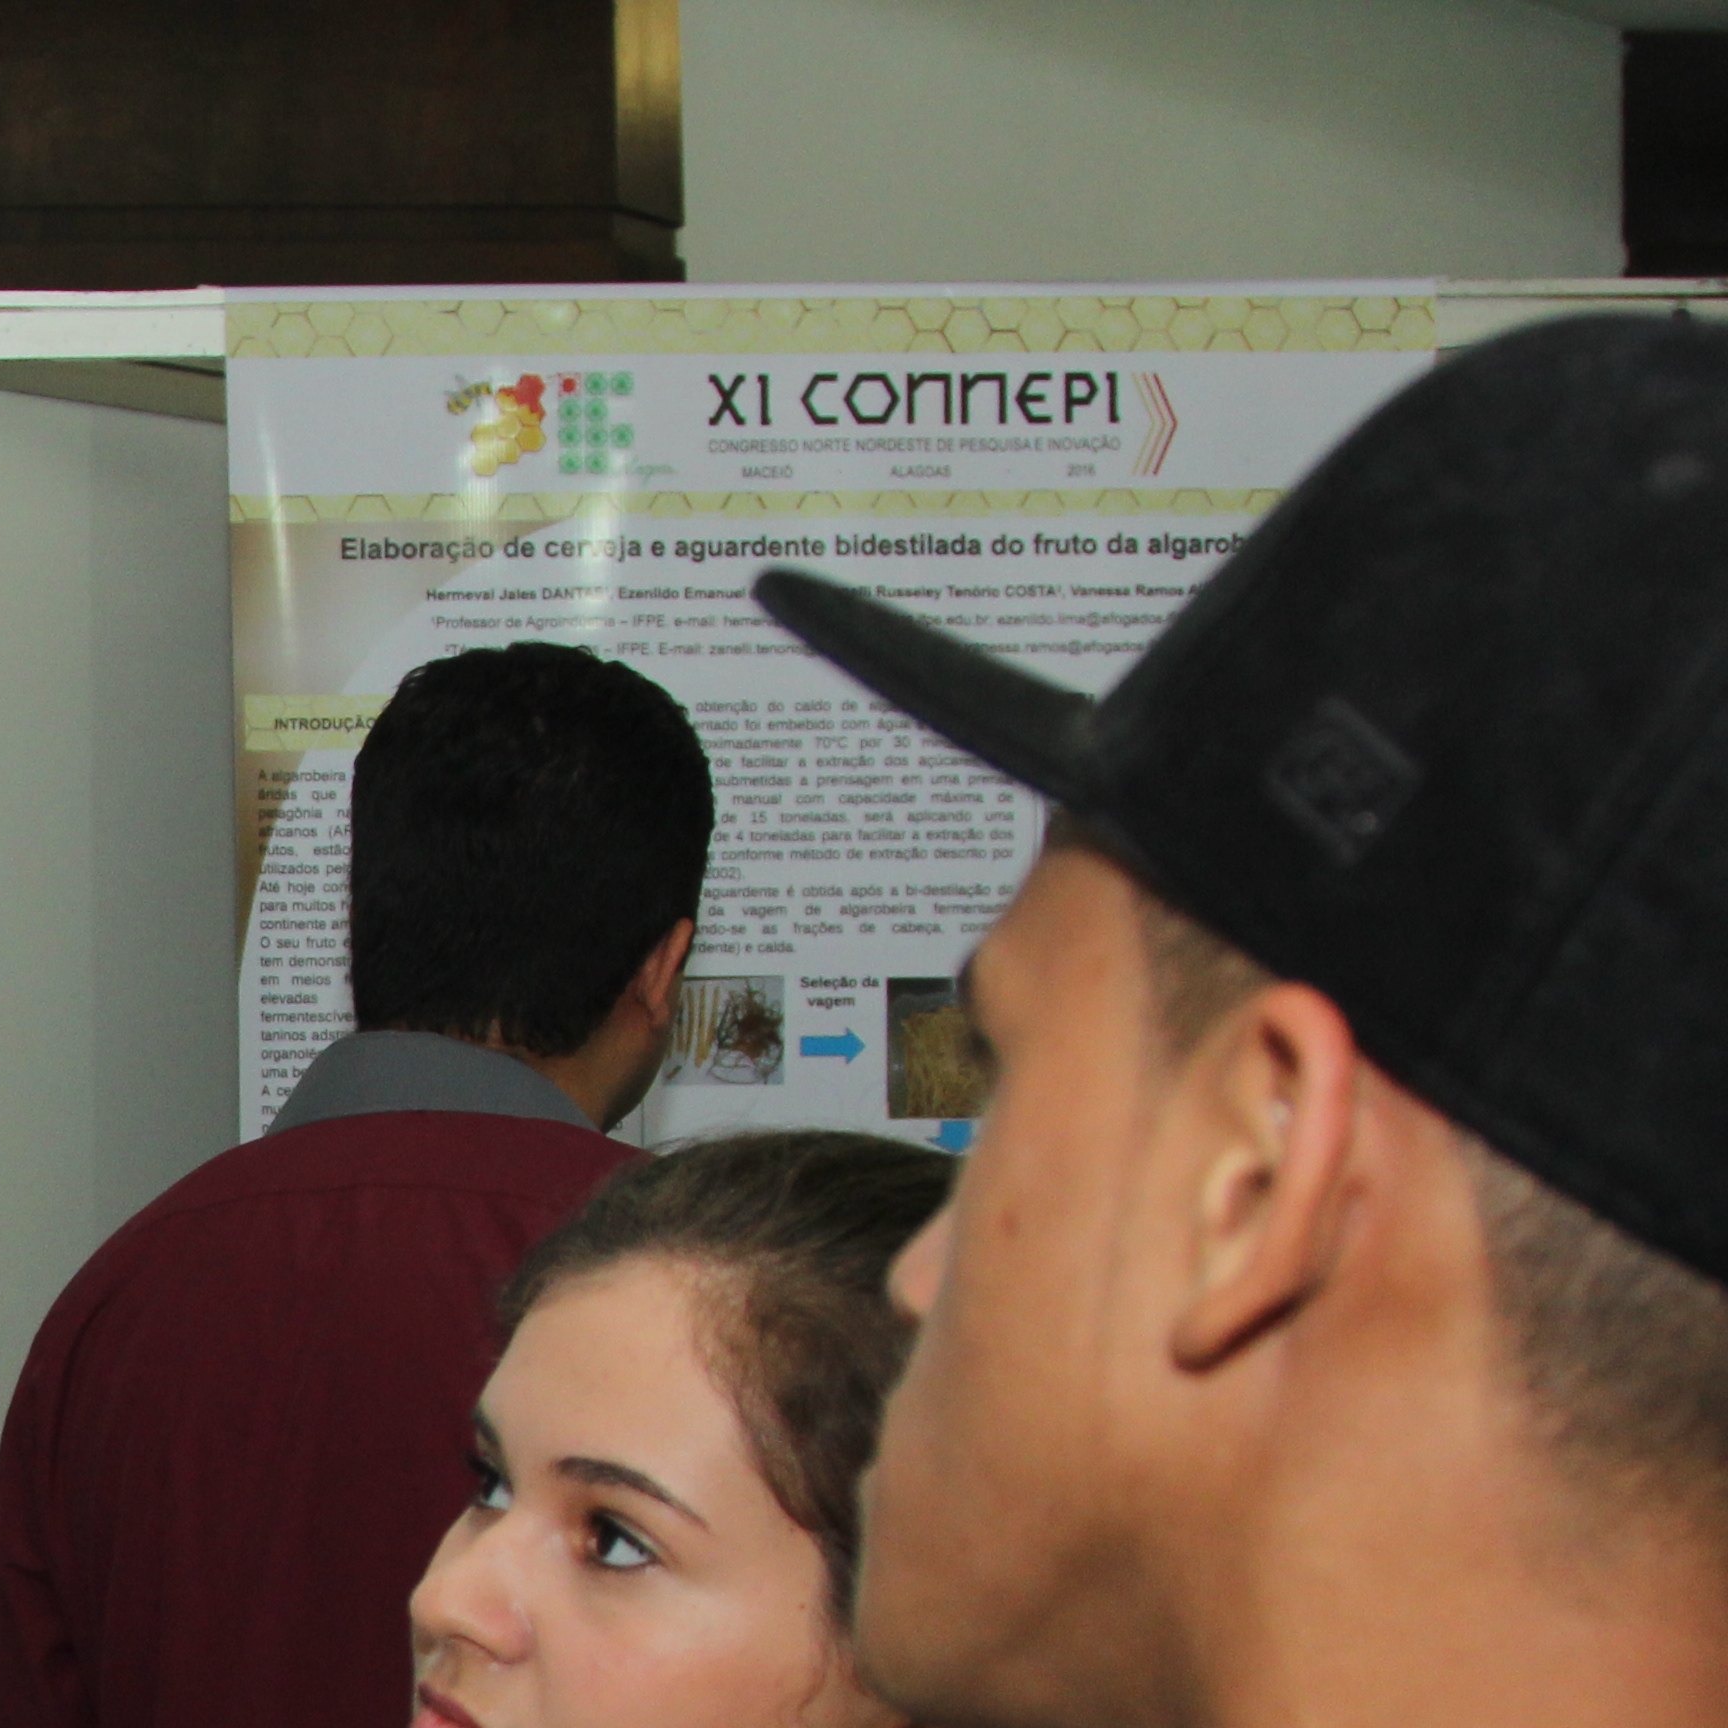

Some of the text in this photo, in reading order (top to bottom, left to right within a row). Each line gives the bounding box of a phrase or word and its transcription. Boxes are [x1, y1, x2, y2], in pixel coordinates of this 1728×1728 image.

[708, 372, 1121, 426] XI CONNEPI
[708, 433, 1121, 453] CONGRESSO NORTE NORDESTE DE PESQUISA E INOVAÇÃO
[742, 463, 794, 478] MACEIÓ
[890, 464, 952, 478] ALAGOAS
[341, 536, 494, 563] Elaboração
[504, 536, 535, 558] de
[651, 540, 665, 556] e
[675, 535, 826, 562] aguardente
[835, 533, 982, 557] bidestilada
[991, 534, 1024, 555] do
[1034, 532, 1097, 555] fruto
[1107, 532, 1138, 555] da
[499, 588, 537, 601] Jales
[948, 584, 1000, 599] Tenório
[1070, 584, 1130, 598] Vanessa
[274, 715, 377, 733] INTRODUÇÃO
[259, 918, 326, 930] continente
[800, 975, 880, 991] Seleção da
[807, 996, 855, 1010] vagem
